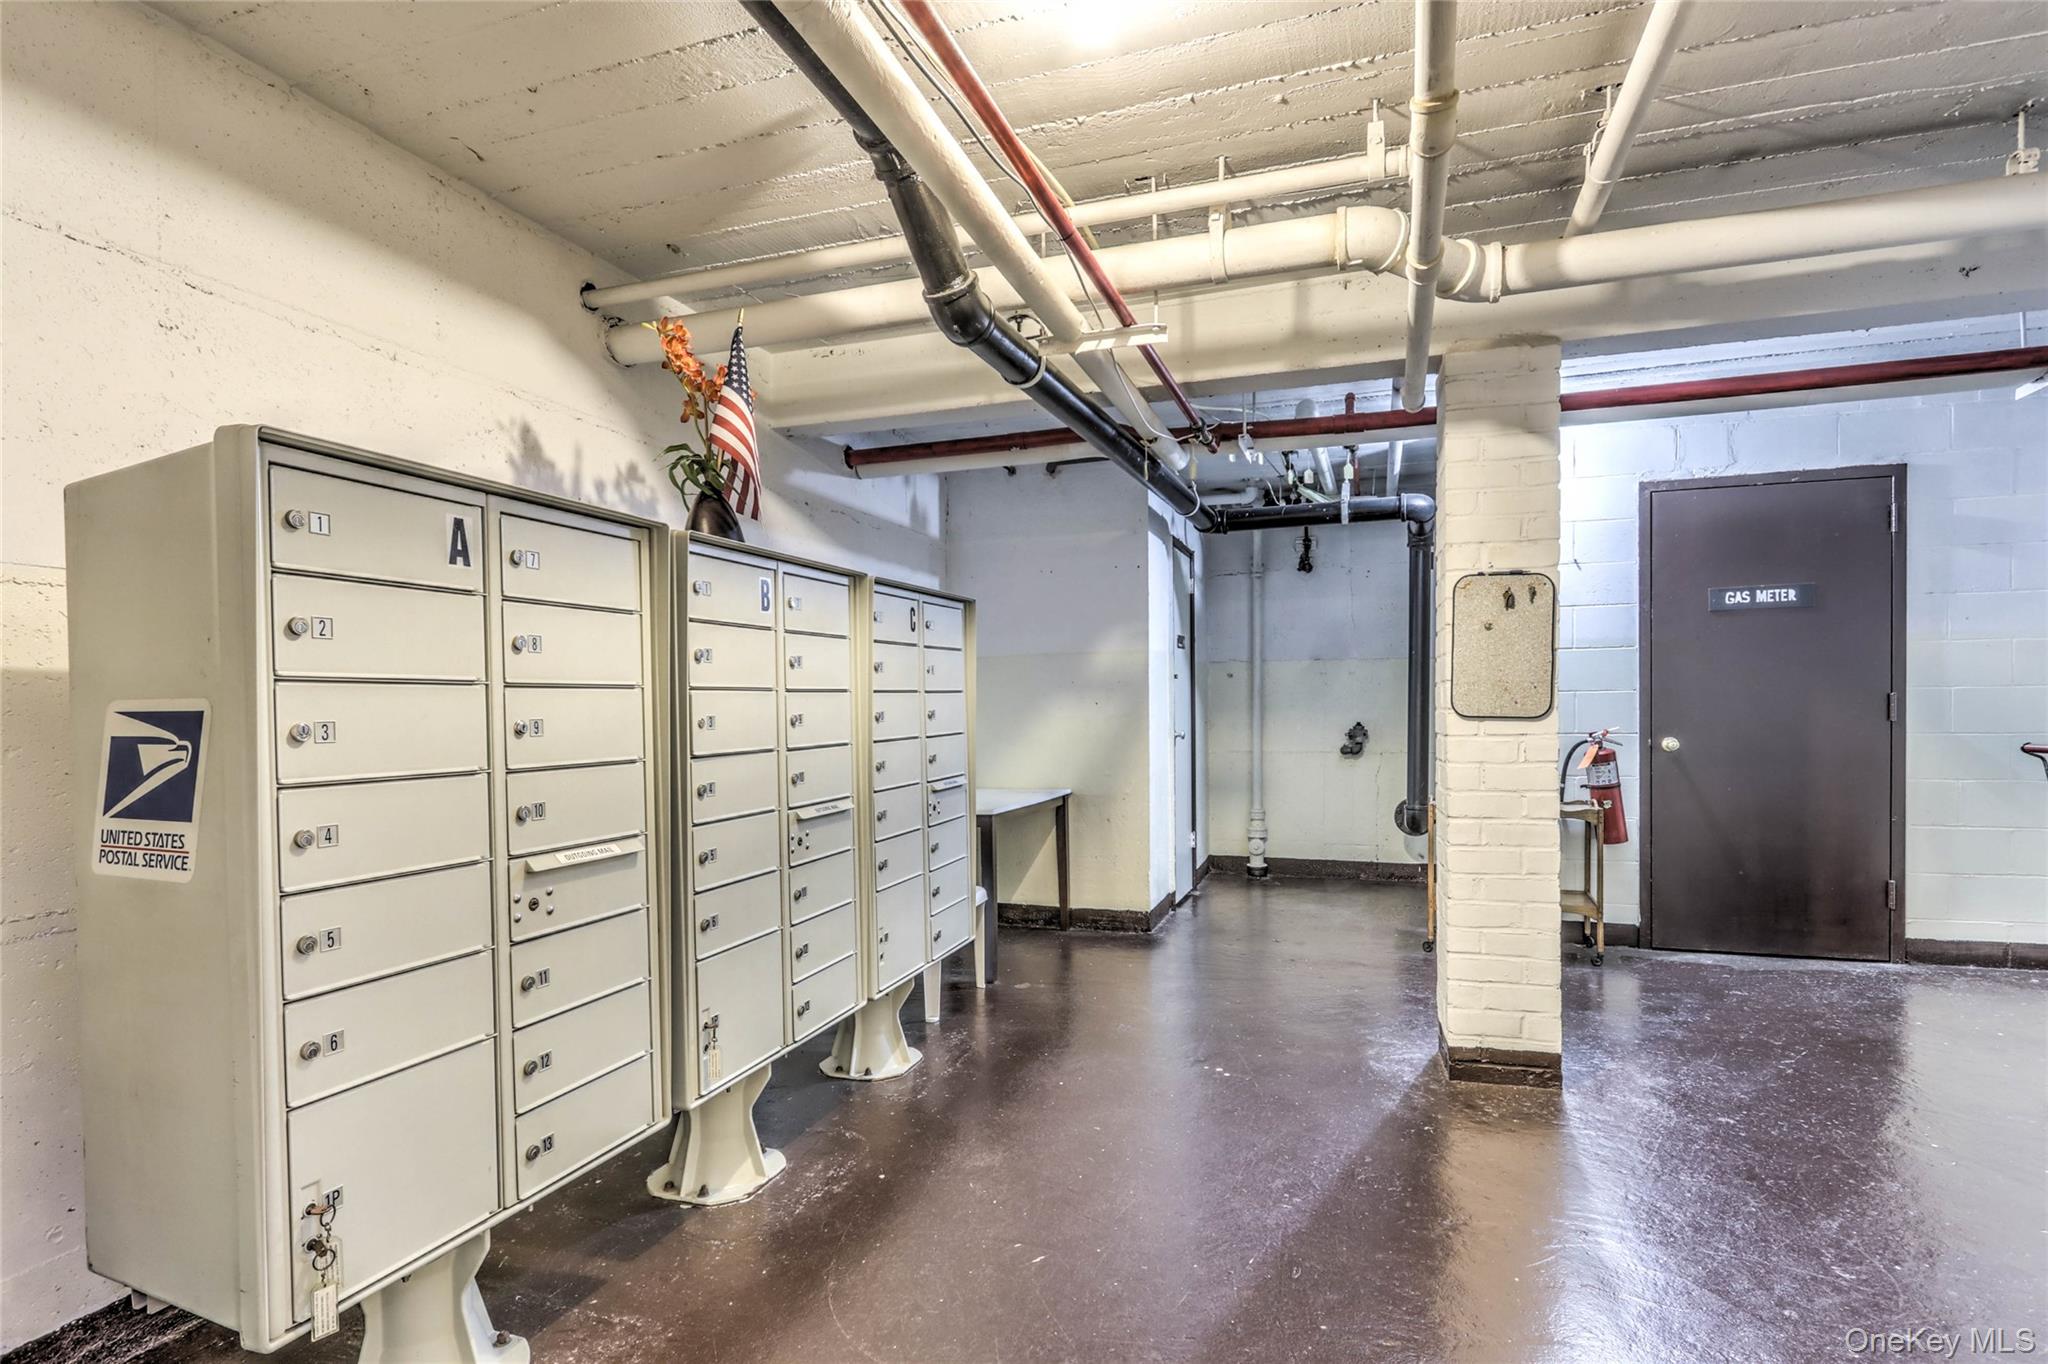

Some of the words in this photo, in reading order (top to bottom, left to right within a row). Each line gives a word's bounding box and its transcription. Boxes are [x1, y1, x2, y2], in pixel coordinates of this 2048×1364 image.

[317, 517, 322, 532] 1
[449, 518, 471, 567] A
[530, 554, 536, 567] 7
[761, 579, 770, 611] B
[1725, 591, 1750, 604] GAS
[1756, 589, 1797, 602] METER
[910, 607, 916, 632] C
[319, 620, 326, 636] 2
[532, 638, 537, 650] 8
[322, 724, 329, 740] 3
[534, 721, 539, 734] 9
[534, 804, 544, 818] 10
[101, 829, 143, 847] UNITED
[145, 832, 185, 849] STATES
[324, 828, 332, 844] 4
[99, 849, 139, 867] POSTAL
[142, 853, 189, 871] SERVICE
[564, 850, 598, 861] OUTGOING
[598, 846, 614, 856] MAIL
[327, 931, 334, 948] 5
[539, 970, 548, 985] 11
[330, 1034, 338, 1051] 6
[541, 1053, 550, 1068] 12
[543, 1136, 553, 1152] 13
[325, 1190, 340, 1205] 1P
